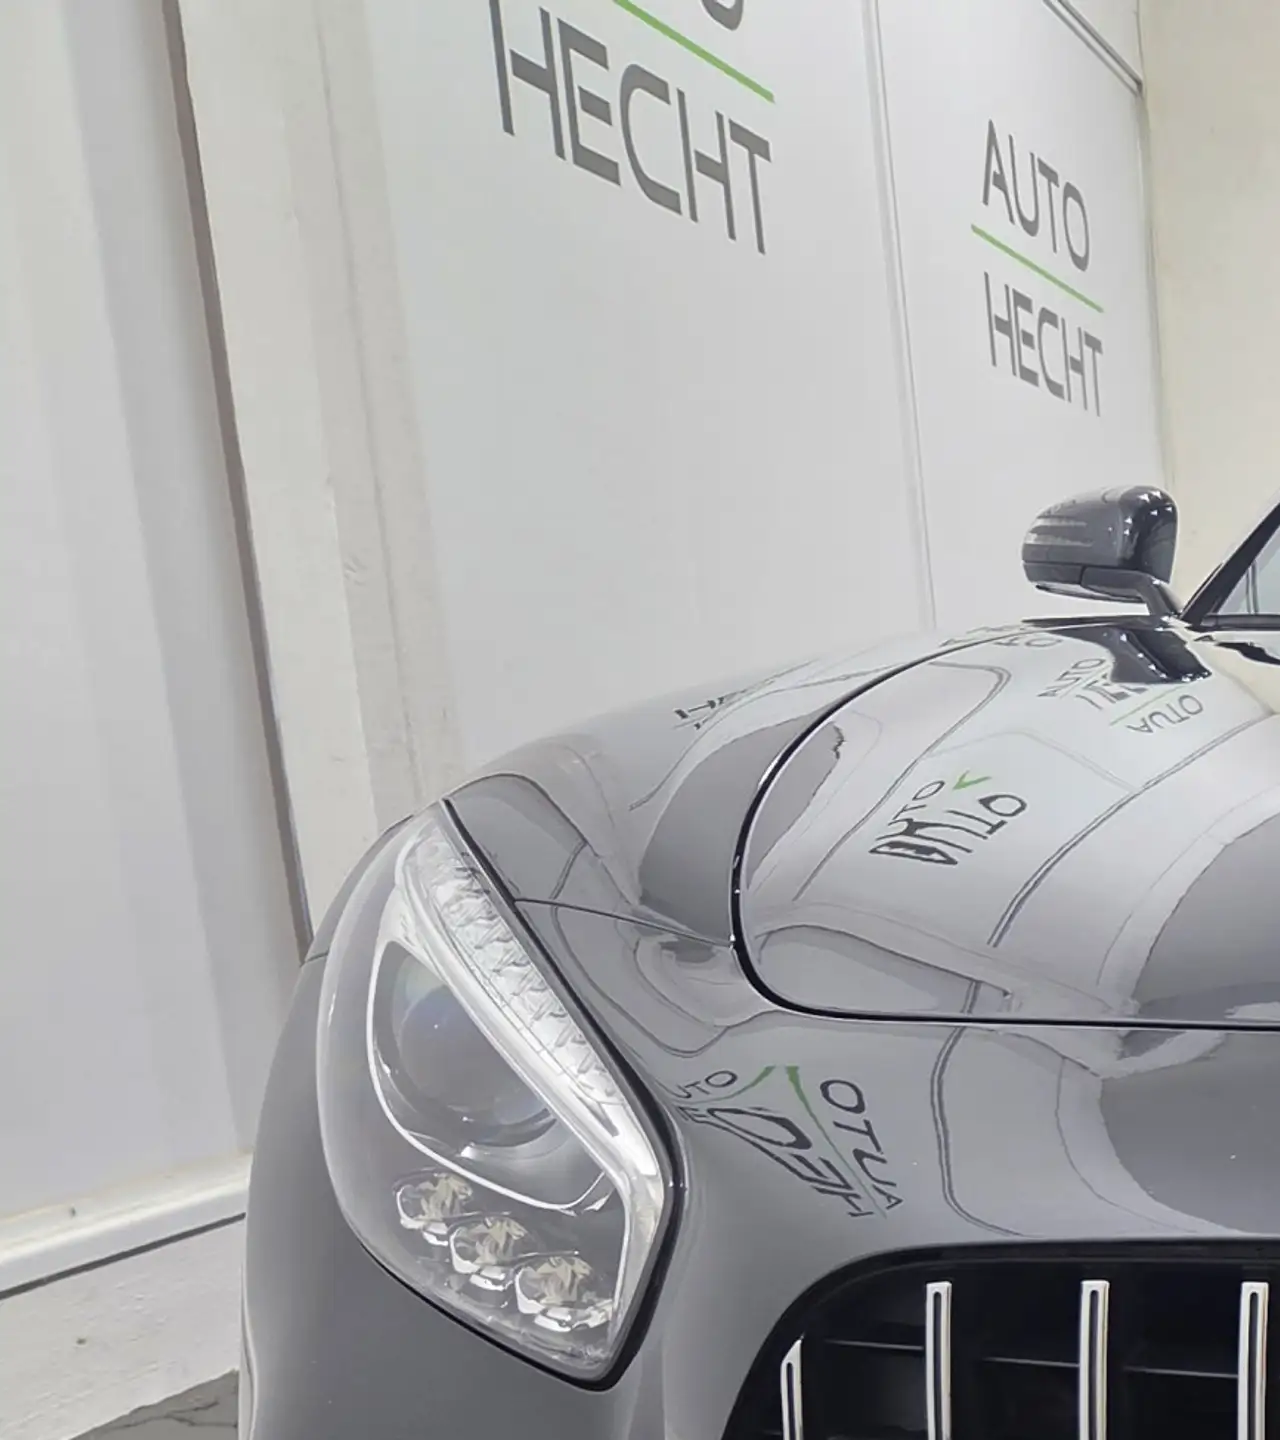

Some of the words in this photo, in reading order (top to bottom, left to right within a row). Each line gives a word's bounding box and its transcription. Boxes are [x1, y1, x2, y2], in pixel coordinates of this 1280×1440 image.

[489, 0, 772, 255] HECHT
[982, 118, 1090, 272] AUTO
[983, 270, 1104, 417] HECHT
